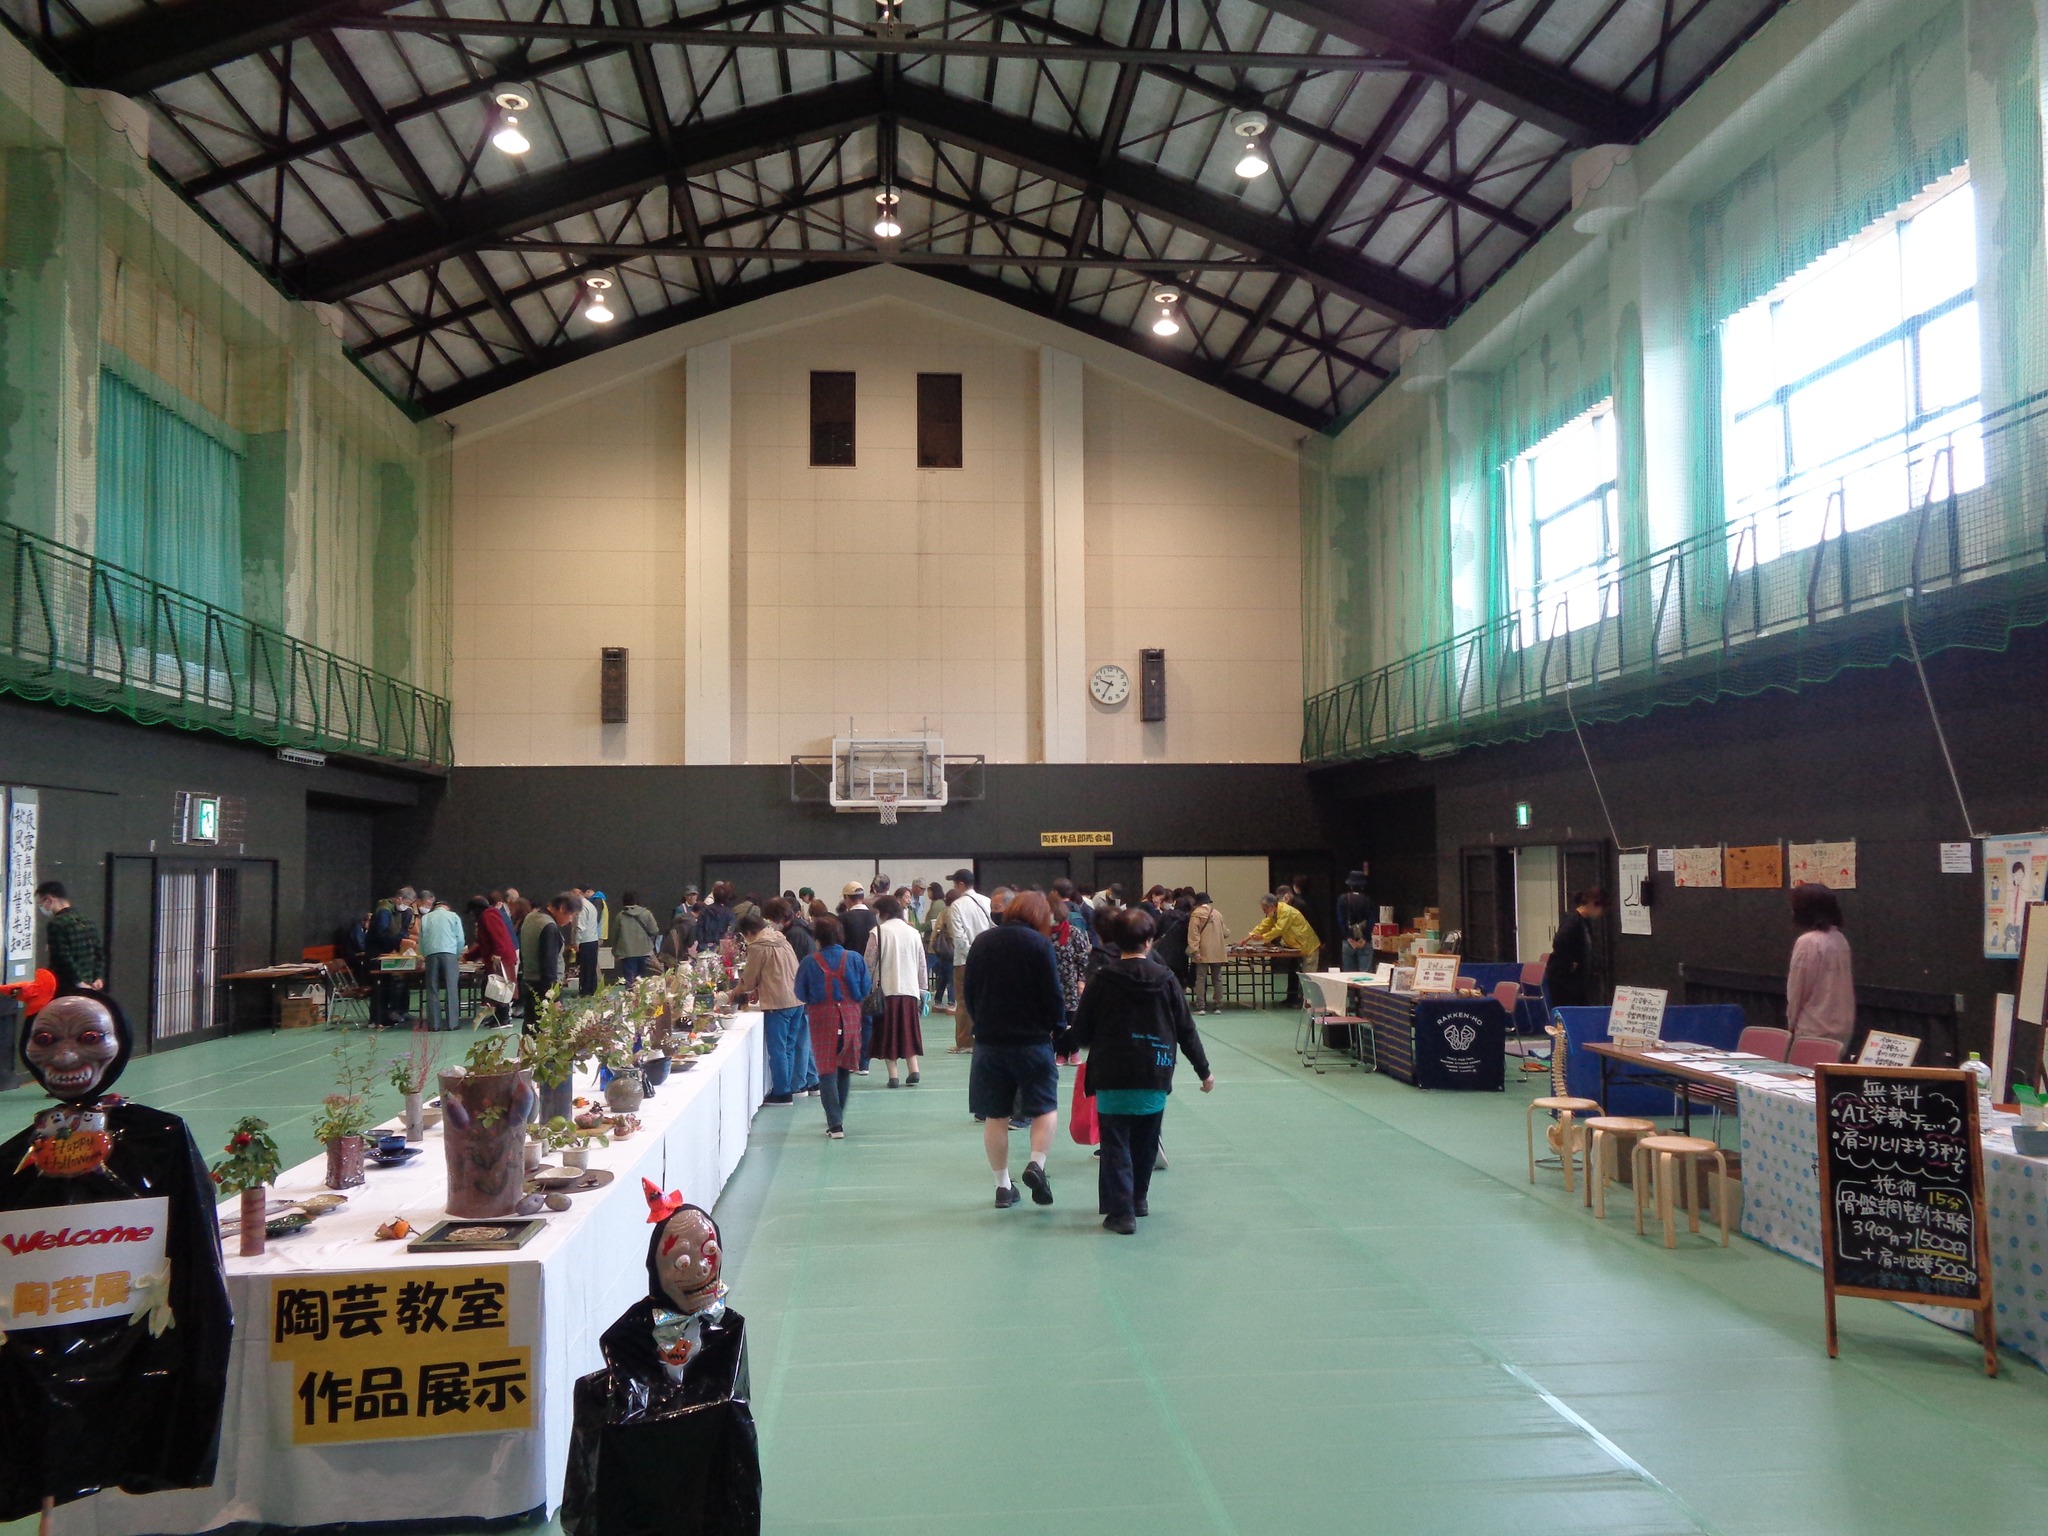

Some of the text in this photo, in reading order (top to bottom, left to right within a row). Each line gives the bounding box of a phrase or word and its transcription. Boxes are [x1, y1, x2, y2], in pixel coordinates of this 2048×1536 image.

[1042, 833, 1112, 844] 陶芸作品即売会場
[1861, 1079, 1923, 1109] 無料
[1871, 1174, 1917, 1198] 施術
[1929, 1191, 1964, 1211] 15分
[1838, 1190, 1971, 1235] 骨盤調整体験
[2, 1226, 154, 1257] Welcome
[12, 1270, 132, 1318] 陶芸展
[275, 1278, 506, 1343] 陶芸教室
[298, 1358, 527, 1426] 作品展示
